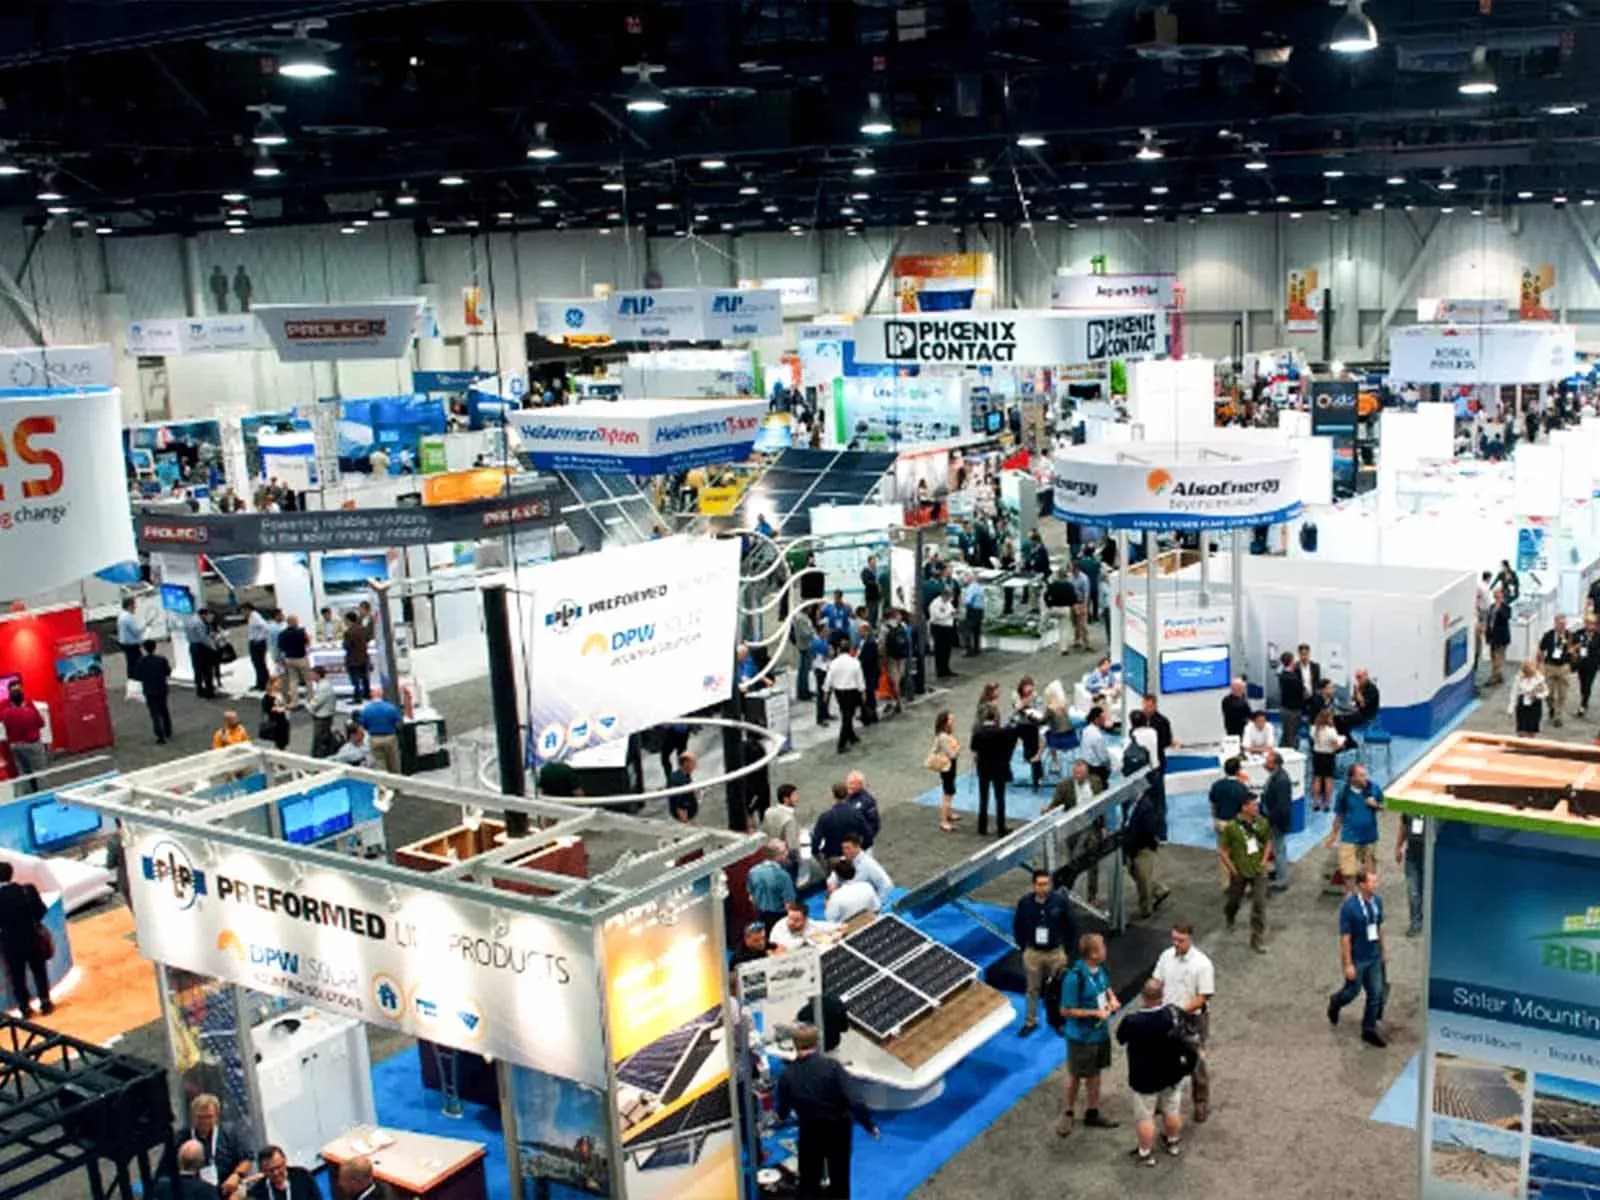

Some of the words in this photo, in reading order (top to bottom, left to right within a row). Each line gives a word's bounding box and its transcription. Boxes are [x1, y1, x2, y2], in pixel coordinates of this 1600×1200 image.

[919, 342, 1016, 361] CONTACT
[1107, 333, 1155, 357] CONTACT
[1171, 478, 1281, 498] AlsoEnergy
[14, 505, 67, 525] change
[612, 623, 656, 651] DPW
[216, 874, 387, 940] PREFORMED
[250, 943, 299, 975] DPW
[1452, 987, 1507, 1013] Solar
